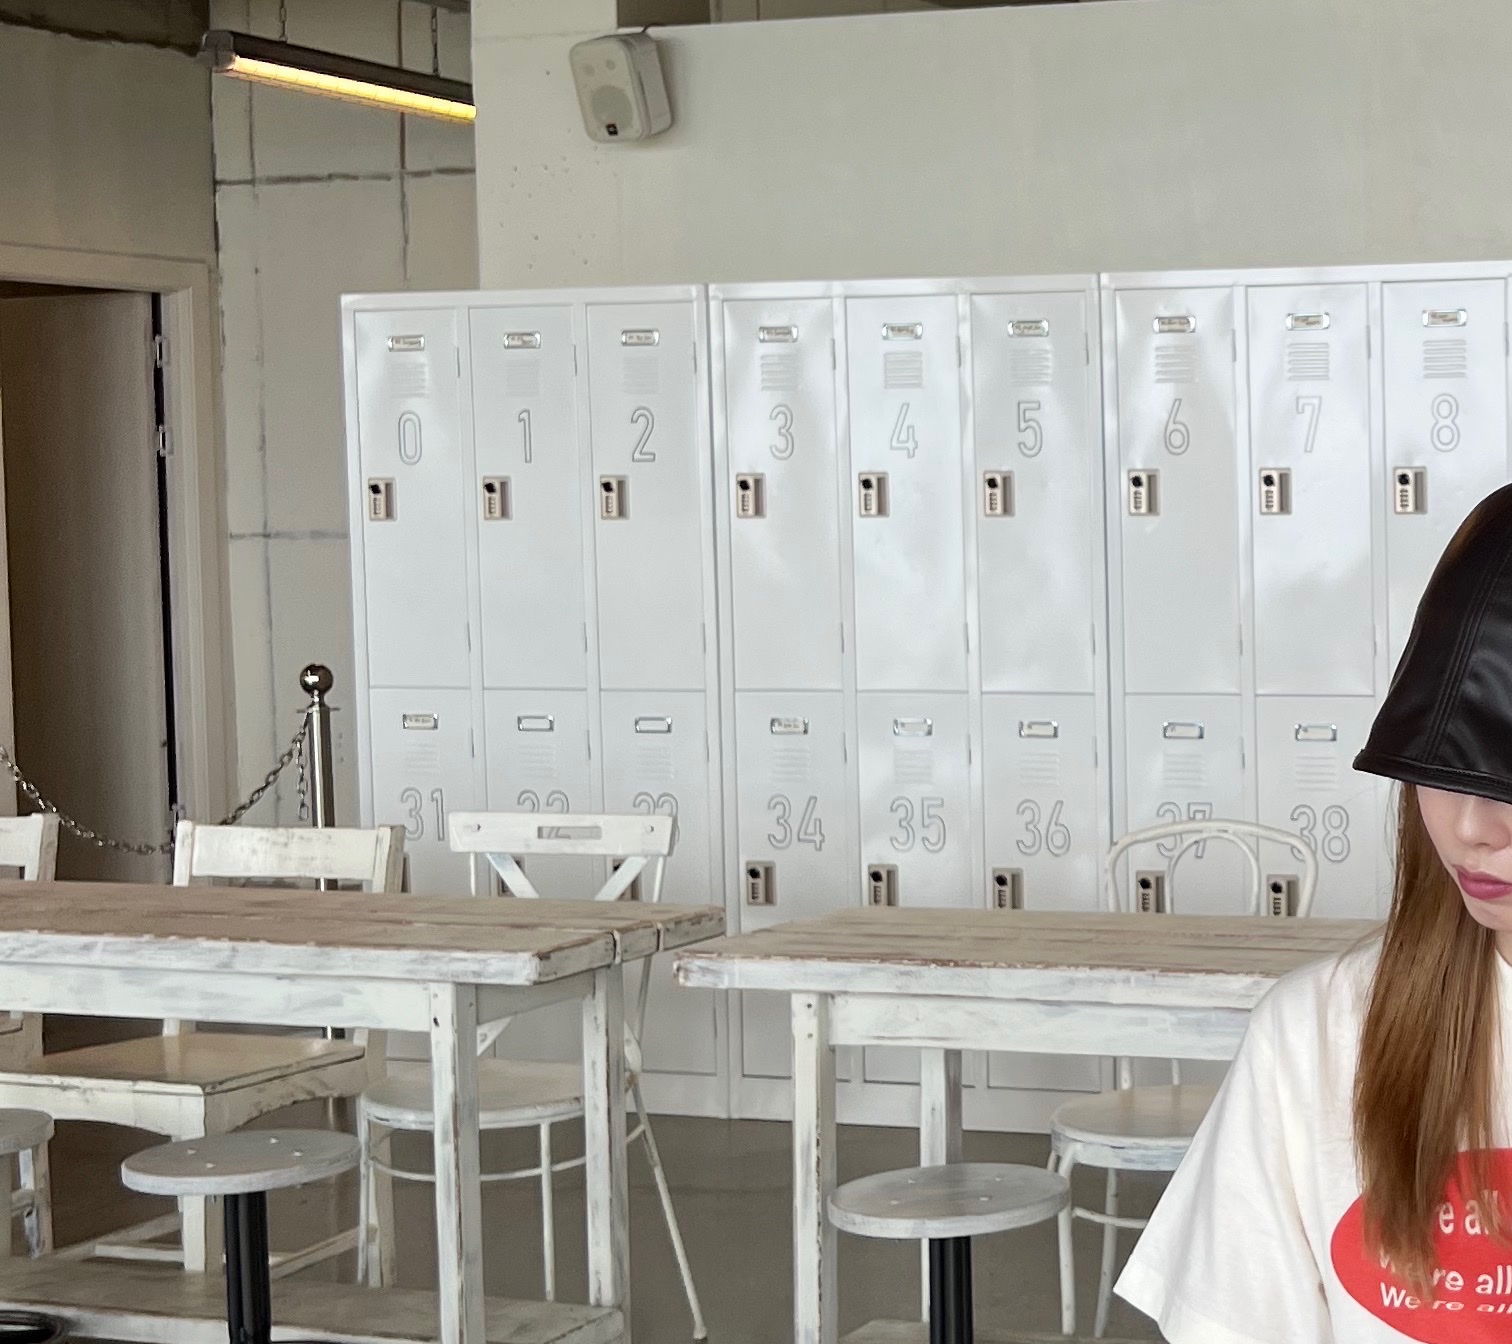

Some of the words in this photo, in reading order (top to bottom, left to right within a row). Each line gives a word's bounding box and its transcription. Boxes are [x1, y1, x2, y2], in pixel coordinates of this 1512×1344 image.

[398, 410, 423, 466] 0
[518, 408, 532, 463] 1
[630, 407, 656, 462] 2
[769, 405, 795, 460] 3
[890, 402, 918, 458] 4
[1016, 401, 1044, 458] 5
[1163, 398, 1192, 456] 6
[1295, 396, 1323, 454] 7
[1429, 394, 1462, 453] 8
[401, 787, 445, 843] 31
[767, 795, 825, 851] 34
[889, 796, 947, 853] 35
[1016, 799, 1071, 856] 36
[1290, 804, 1351, 863] 38
[1475, 1264, 1512, 1295] all
